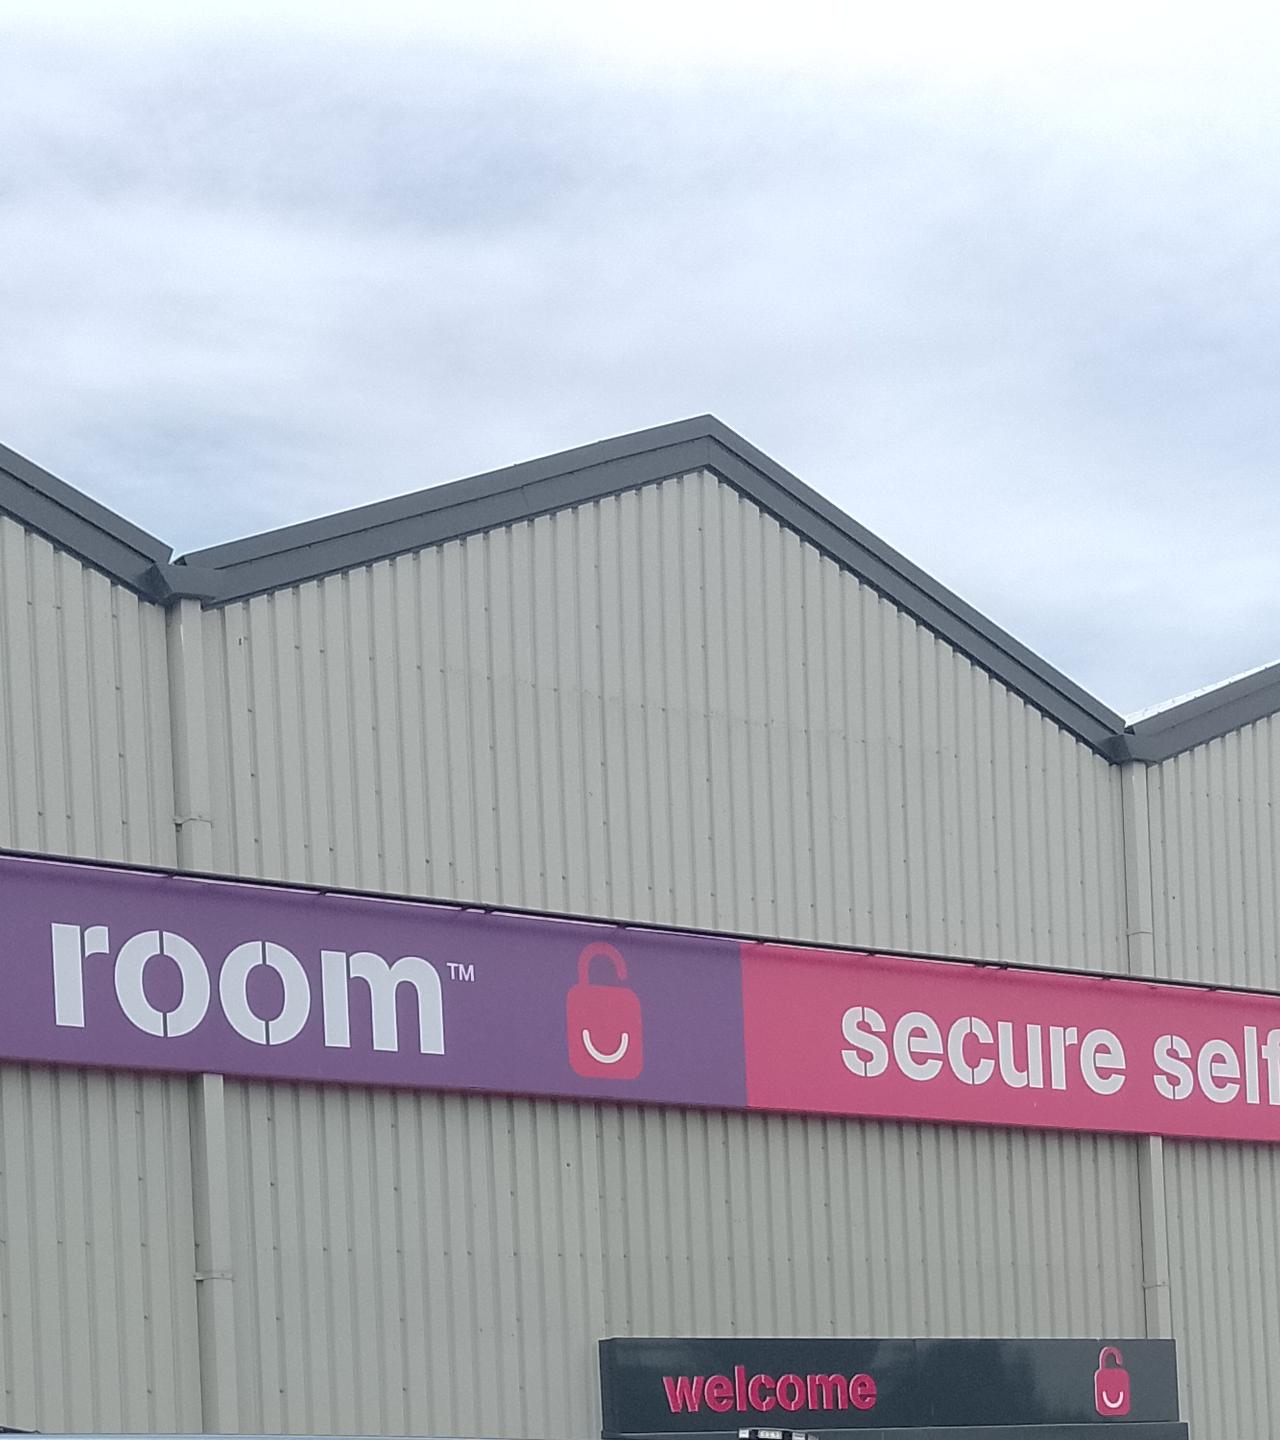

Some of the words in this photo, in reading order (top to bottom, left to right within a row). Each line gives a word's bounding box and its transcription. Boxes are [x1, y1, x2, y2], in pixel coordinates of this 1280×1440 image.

[51, 922, 445, 1055] room
[840, 1006, 1126, 1095] secure
[662, 1365, 877, 1413] welcome
